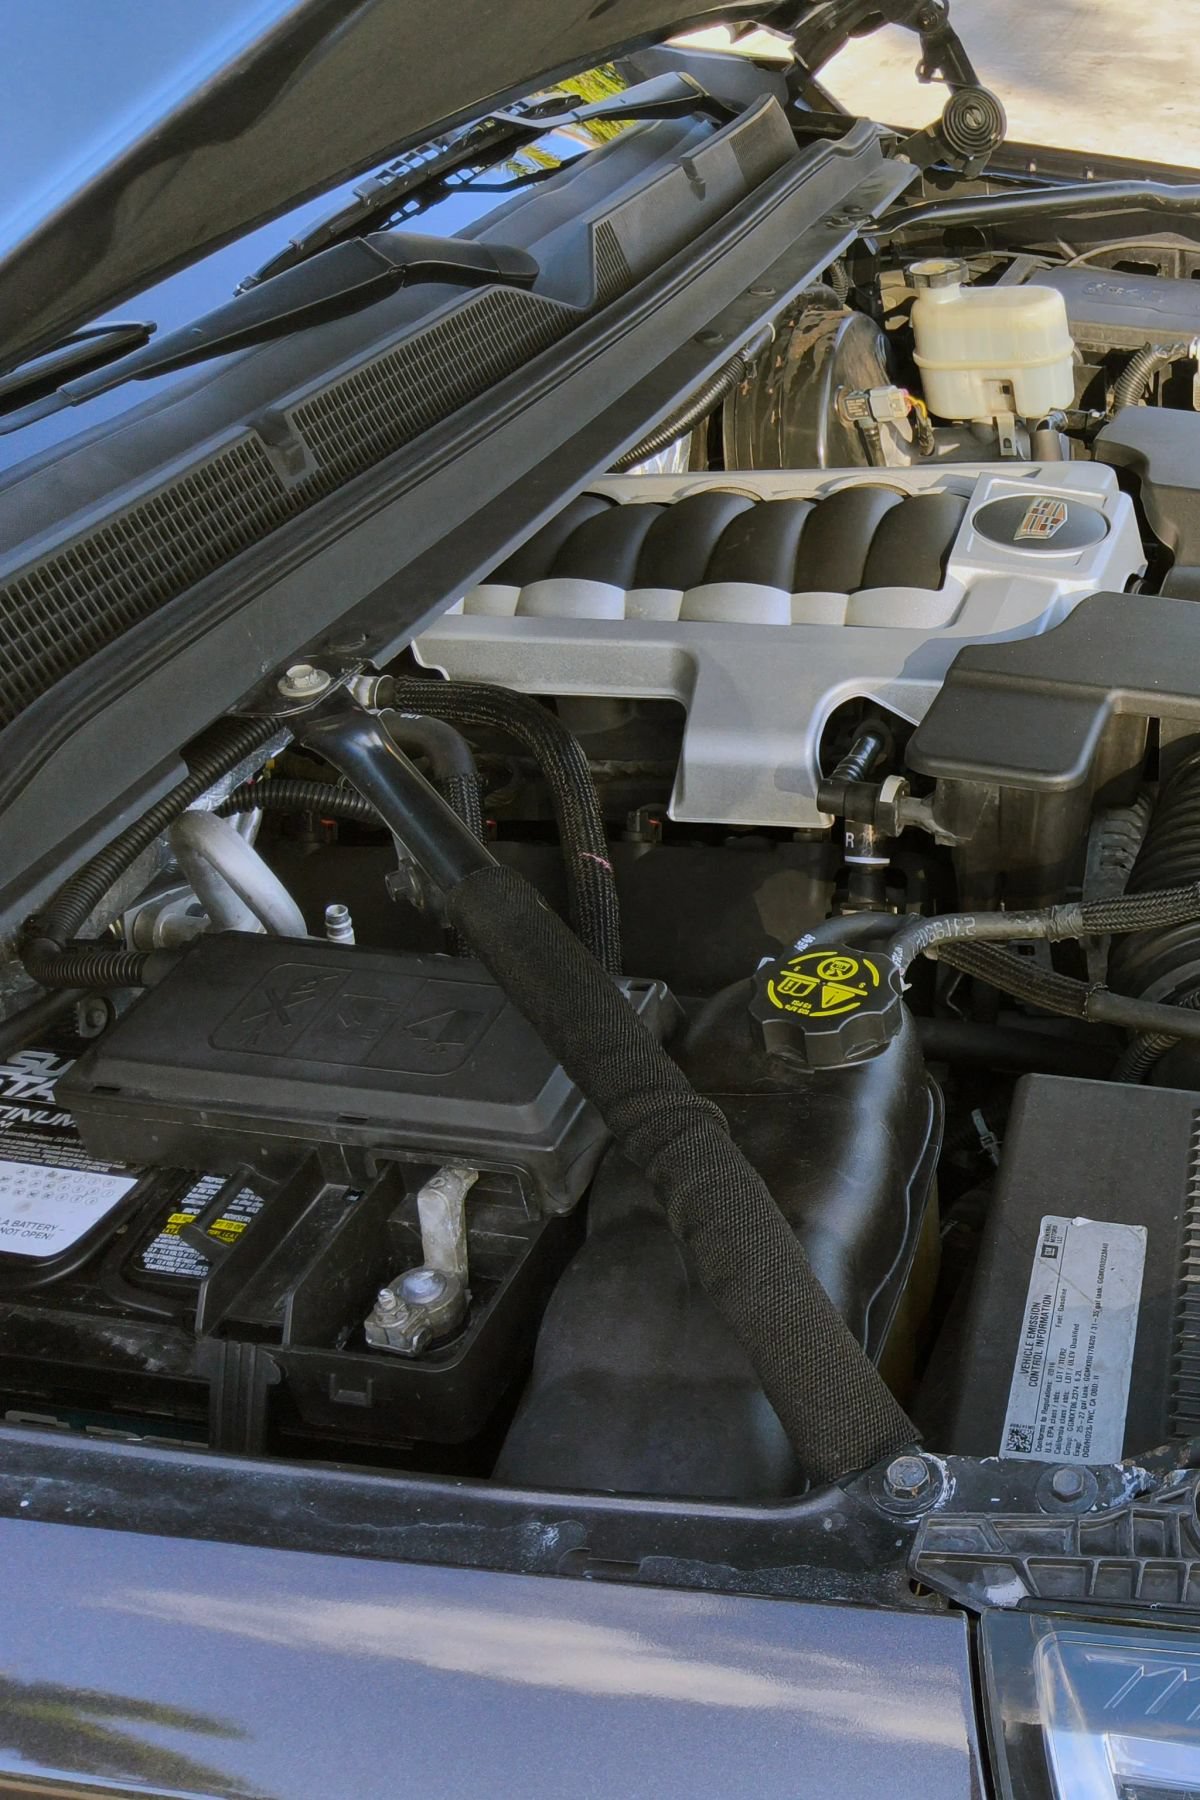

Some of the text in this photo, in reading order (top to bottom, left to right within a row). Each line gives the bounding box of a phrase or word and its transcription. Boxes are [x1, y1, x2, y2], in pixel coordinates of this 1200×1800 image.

[0, 1050, 77, 1077] SU
[0, 1105, 78, 1128] TINUM
[10, 1219, 57, 1232] BATTERY
[21, 1229, 55, 1241] OPEN!
[1058, 1288, 1067, 1312] Gasoline
[1021, 1301, 1040, 1375] VEHICLE EMISSION
[1030, 1294, 1052, 1388] CONTROL INFORMATION
[1070, 1323, 1079, 1349] Qualified
[1067, 1351, 1076, 1367] ULEV
[1089, 1398, 1096, 1407] CA
[1035, 1424, 1045, 1453] Conforms
[1047, 1425, 1055, 1438] EPA
[1054, 1425, 1064, 1455] California
